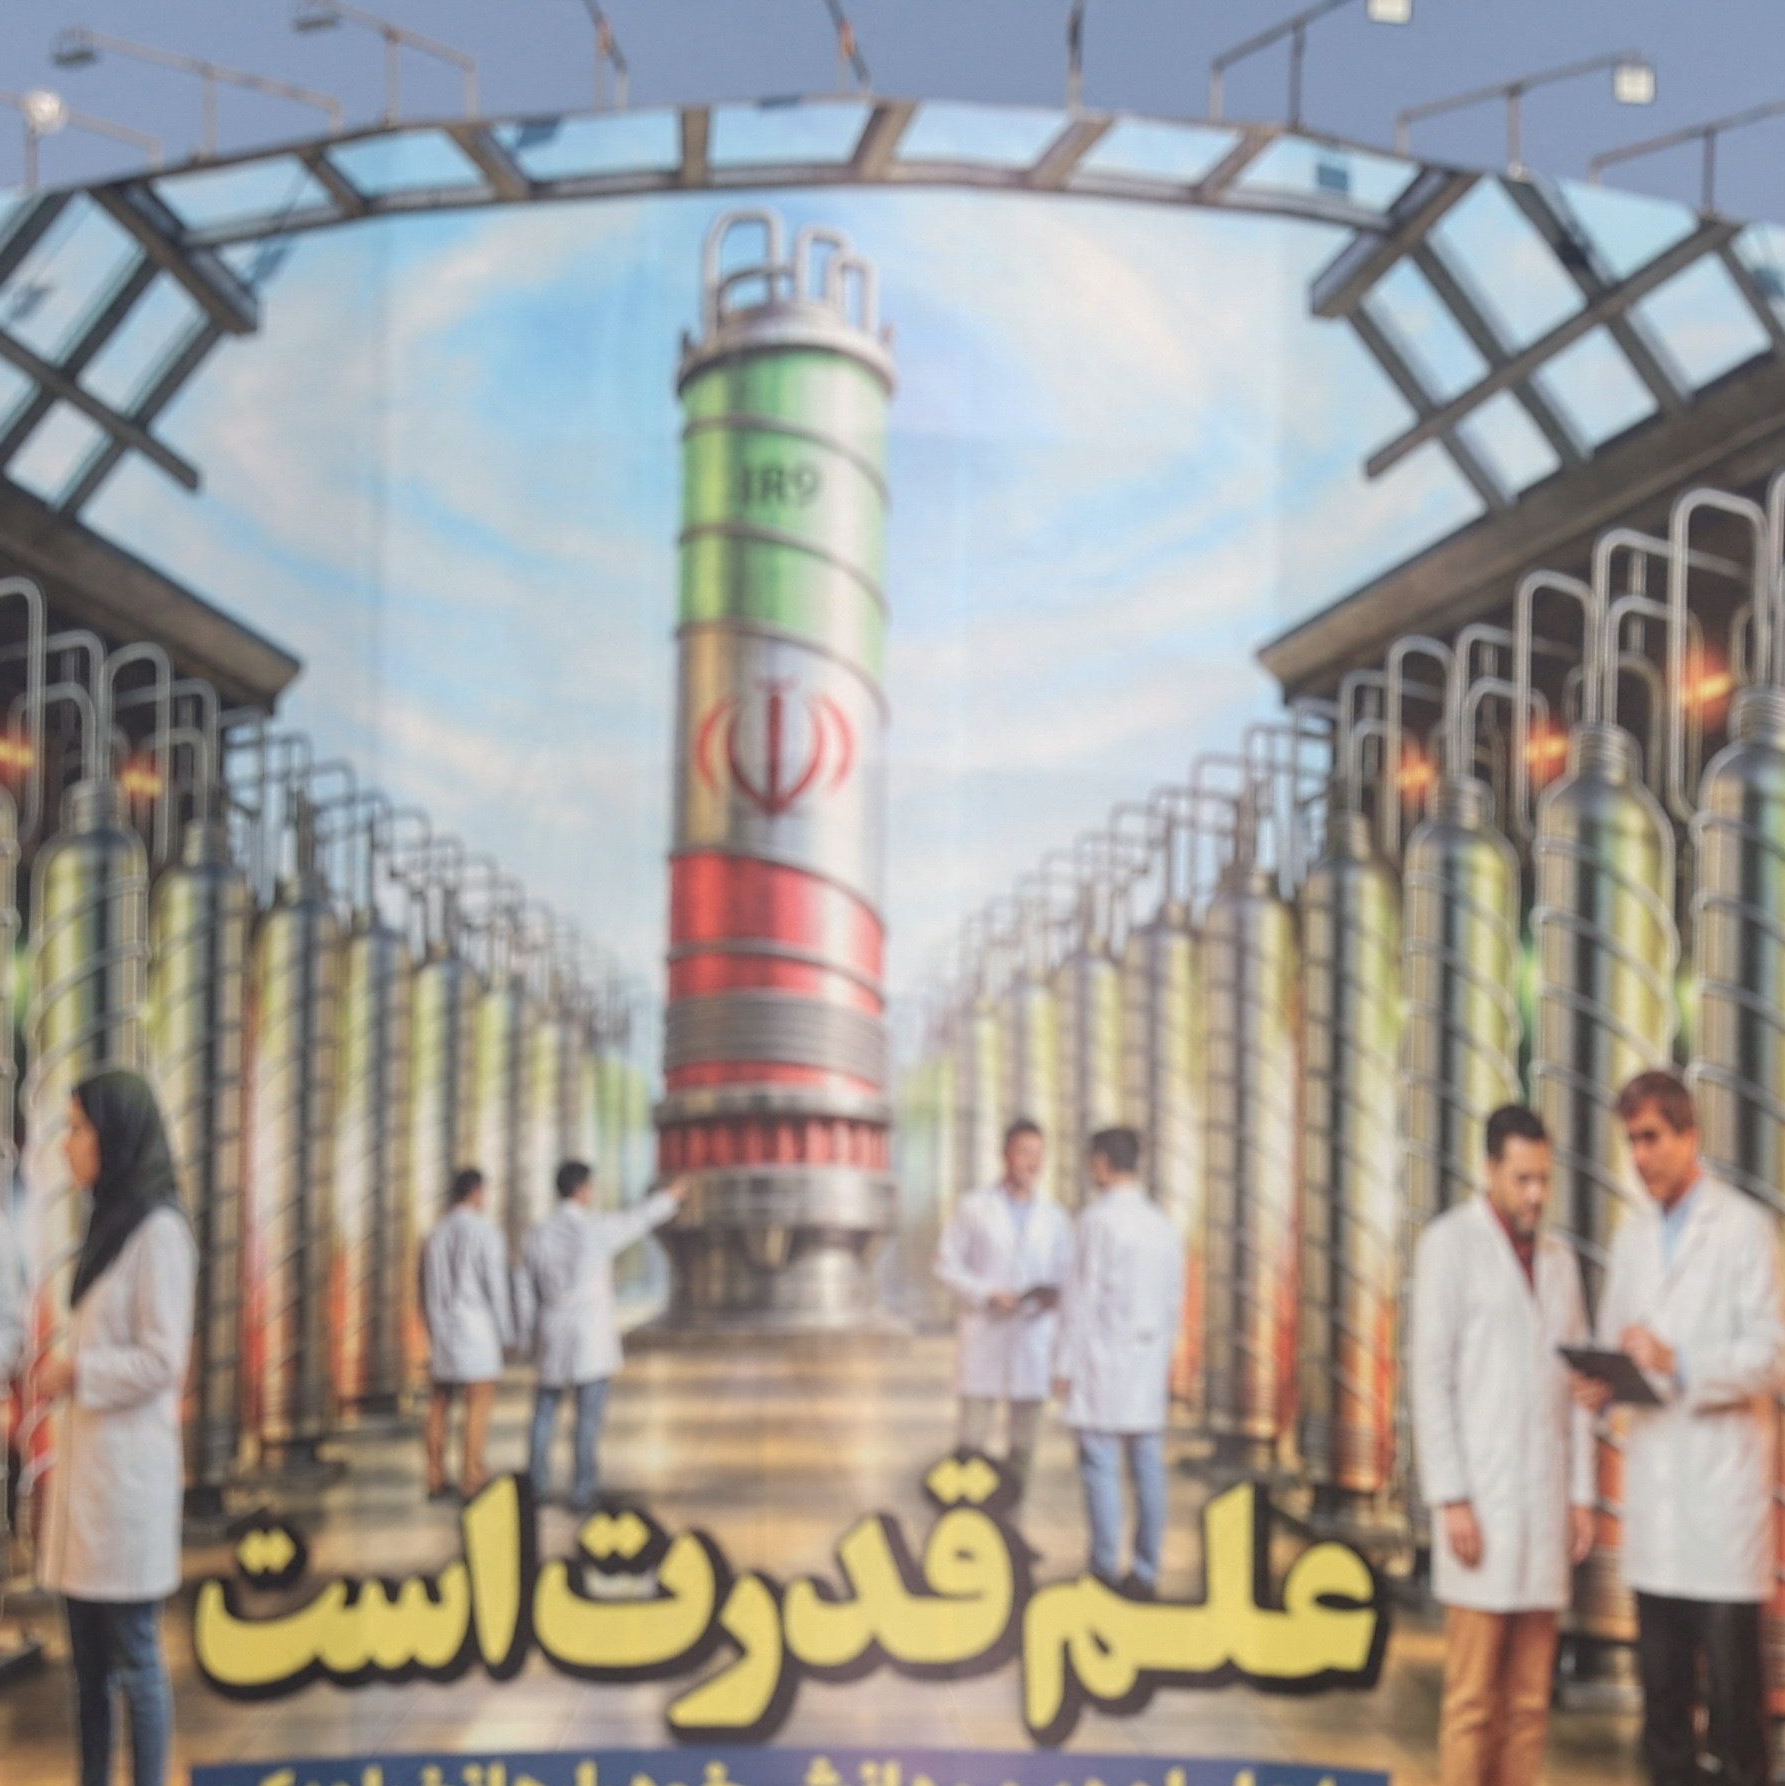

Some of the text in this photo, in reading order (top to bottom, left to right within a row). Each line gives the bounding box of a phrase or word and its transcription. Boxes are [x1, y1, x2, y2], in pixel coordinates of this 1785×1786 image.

[190, 1456, 1382, 1734] علم قدرت است
